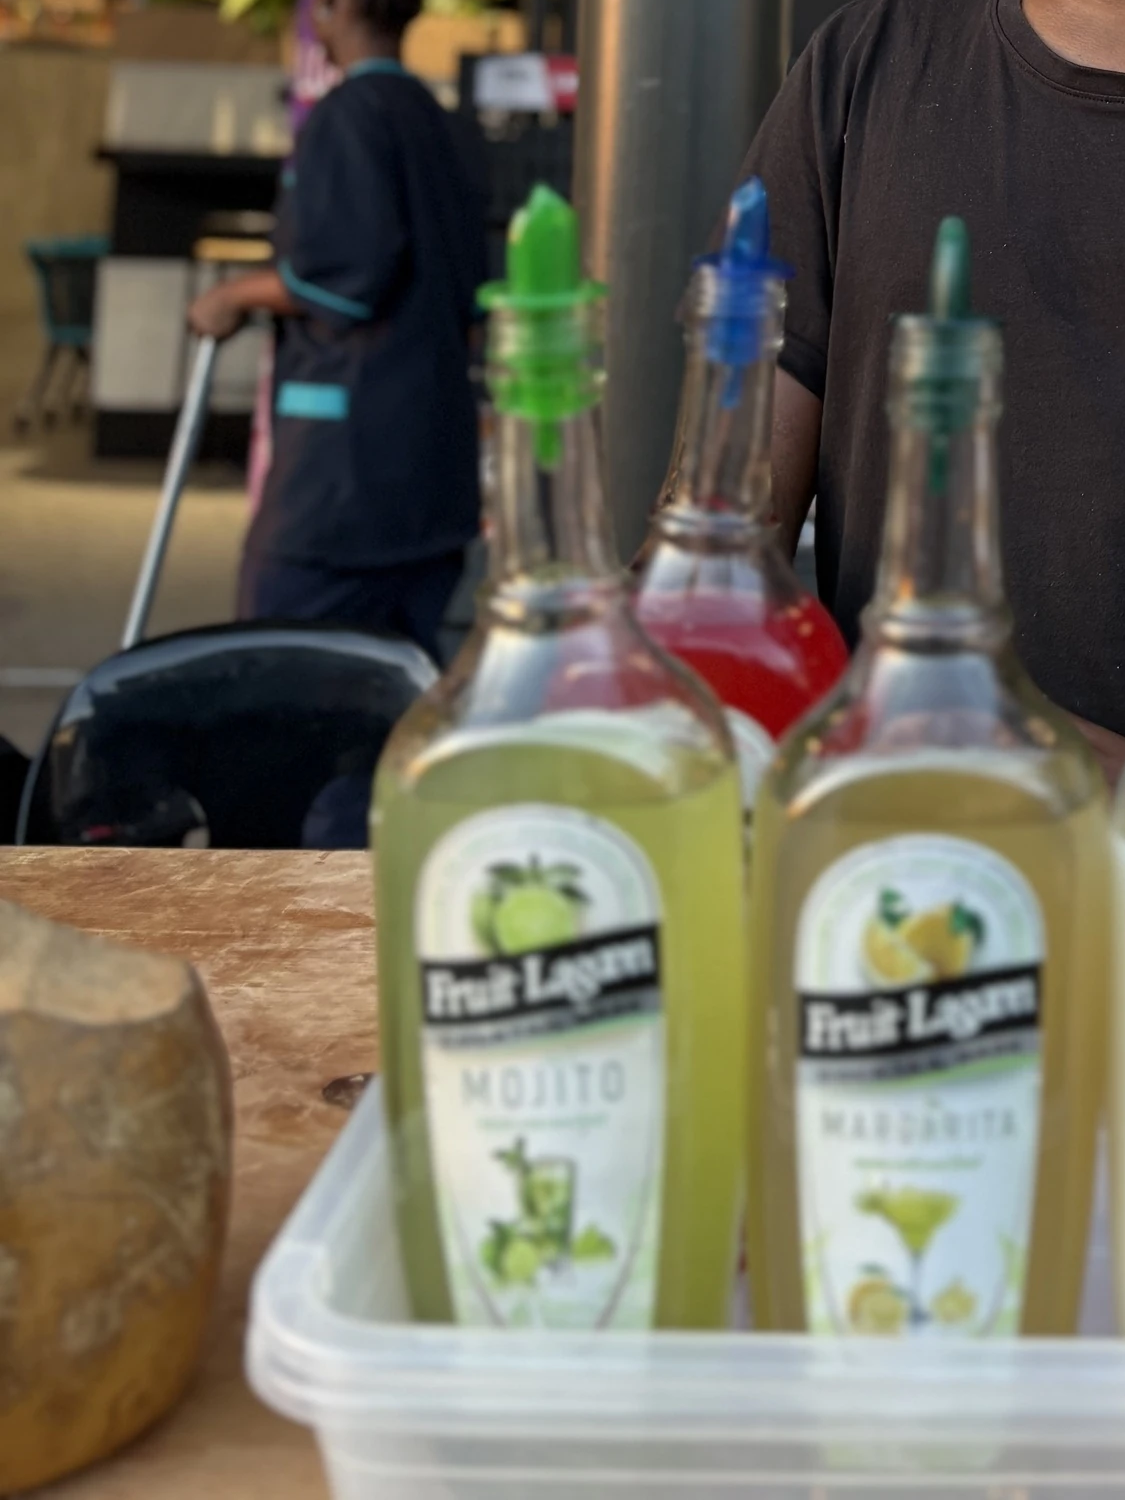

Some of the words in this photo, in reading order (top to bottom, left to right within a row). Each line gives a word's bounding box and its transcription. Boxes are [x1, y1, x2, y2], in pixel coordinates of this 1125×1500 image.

[426, 964, 521, 1018] Fruit
[807, 998, 903, 1051] Fruit
[461, 1058, 626, 1109] MOJITO
